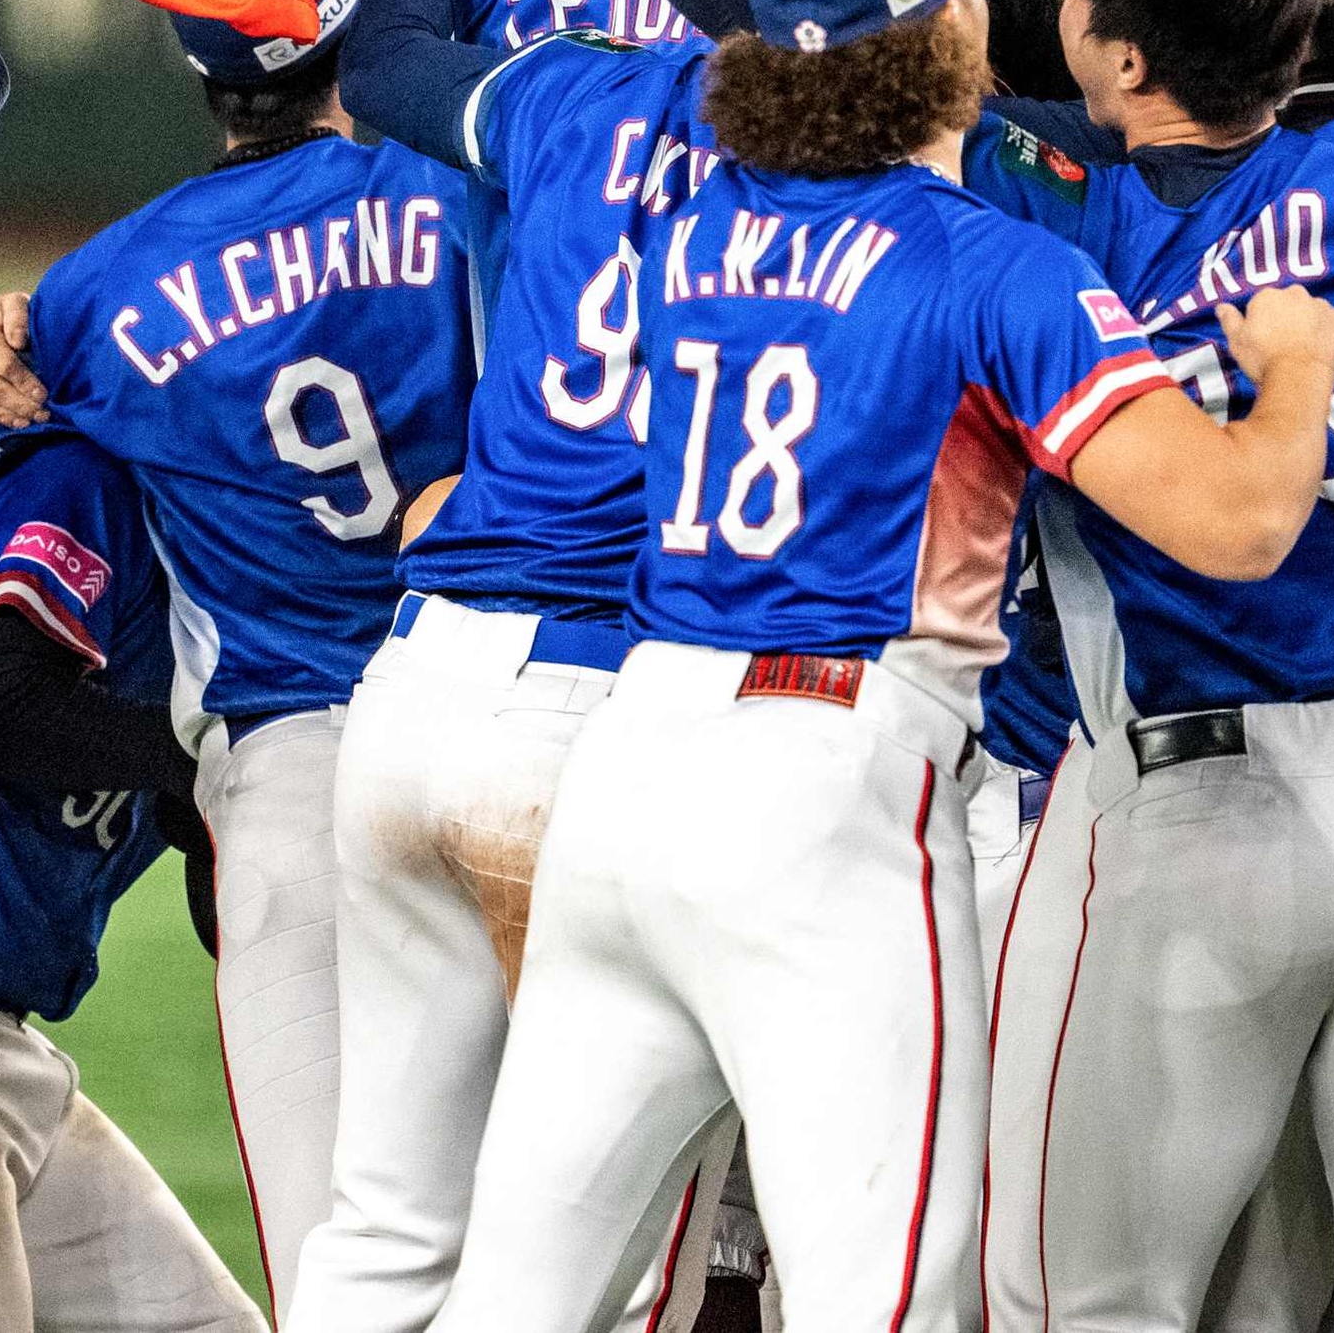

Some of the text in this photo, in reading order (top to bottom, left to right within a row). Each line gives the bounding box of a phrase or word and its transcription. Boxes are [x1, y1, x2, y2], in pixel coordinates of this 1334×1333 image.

[110, 196, 441, 387] C.Y.CHANG
[539, 233, 651, 444] 9
[664, 209, 898, 315] K.W.LIN
[262, 355, 400, 542] 9
[660, 338, 819, 561] 18
[9, 532, 83, 575] DAISO
